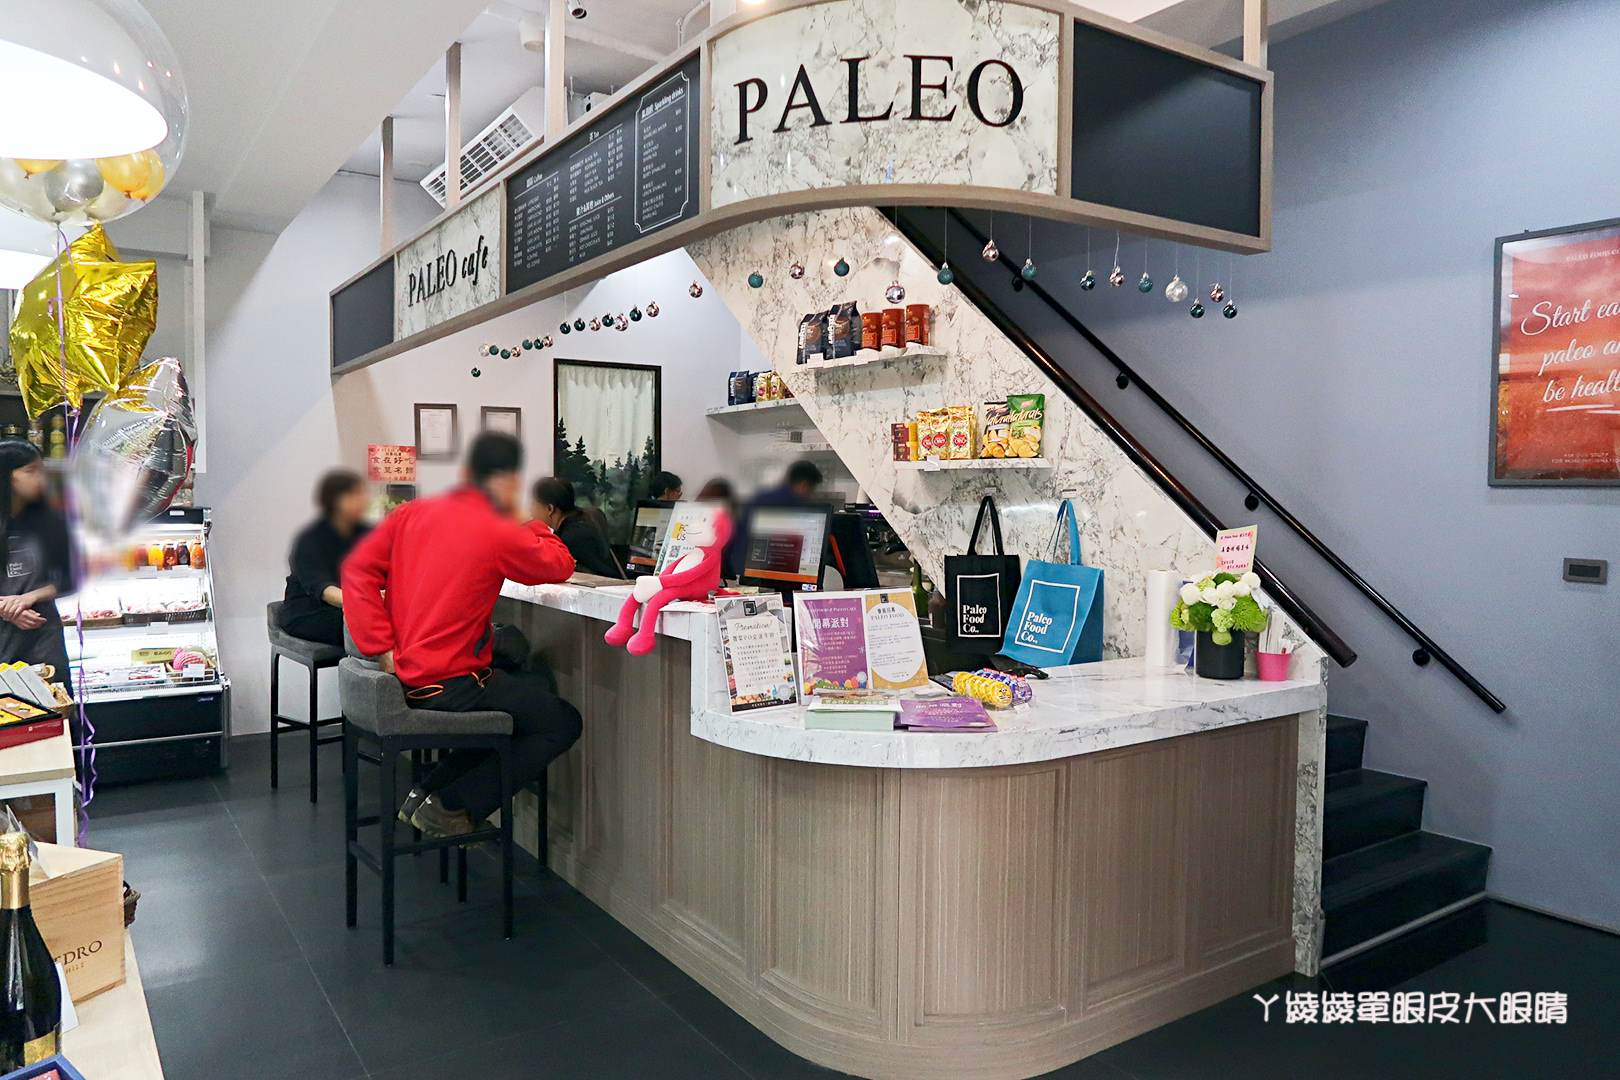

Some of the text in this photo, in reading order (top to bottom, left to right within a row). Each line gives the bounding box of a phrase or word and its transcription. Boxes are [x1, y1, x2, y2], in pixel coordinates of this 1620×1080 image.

[671, 87, 684, 100] drinks
[734, 55, 1023, 144] PALEO
[408, 235, 488, 307] PALEO cafe
[1521, 299, 1591, 335] Start
[1538, 338, 1595, 376] paleo
[1543, 380, 1566, 402] be
[963, 614, 985, 624] Food
[1024, 621, 1048, 635] Food
